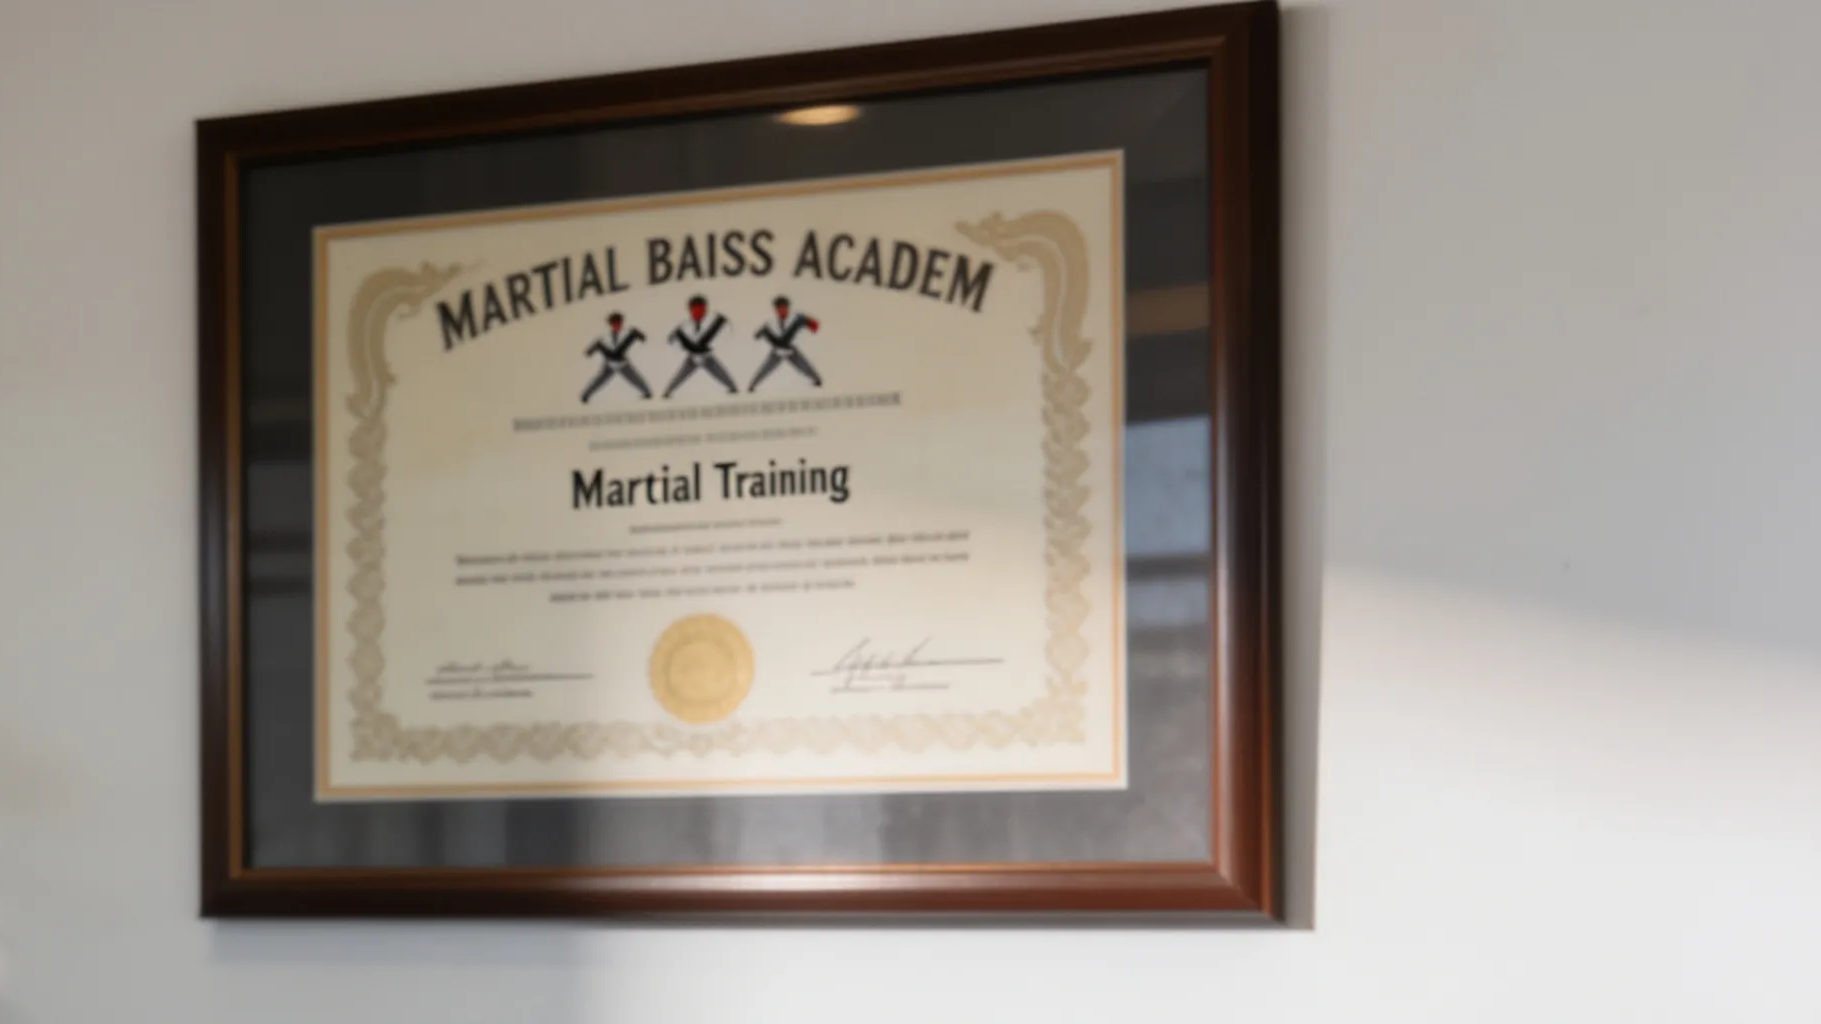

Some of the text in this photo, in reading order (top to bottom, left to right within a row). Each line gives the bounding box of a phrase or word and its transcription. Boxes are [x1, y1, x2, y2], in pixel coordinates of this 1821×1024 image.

[436, 230, 995, 352] MARTIAL BAISS ACADEM
[571, 458, 851, 510] Martial Training
